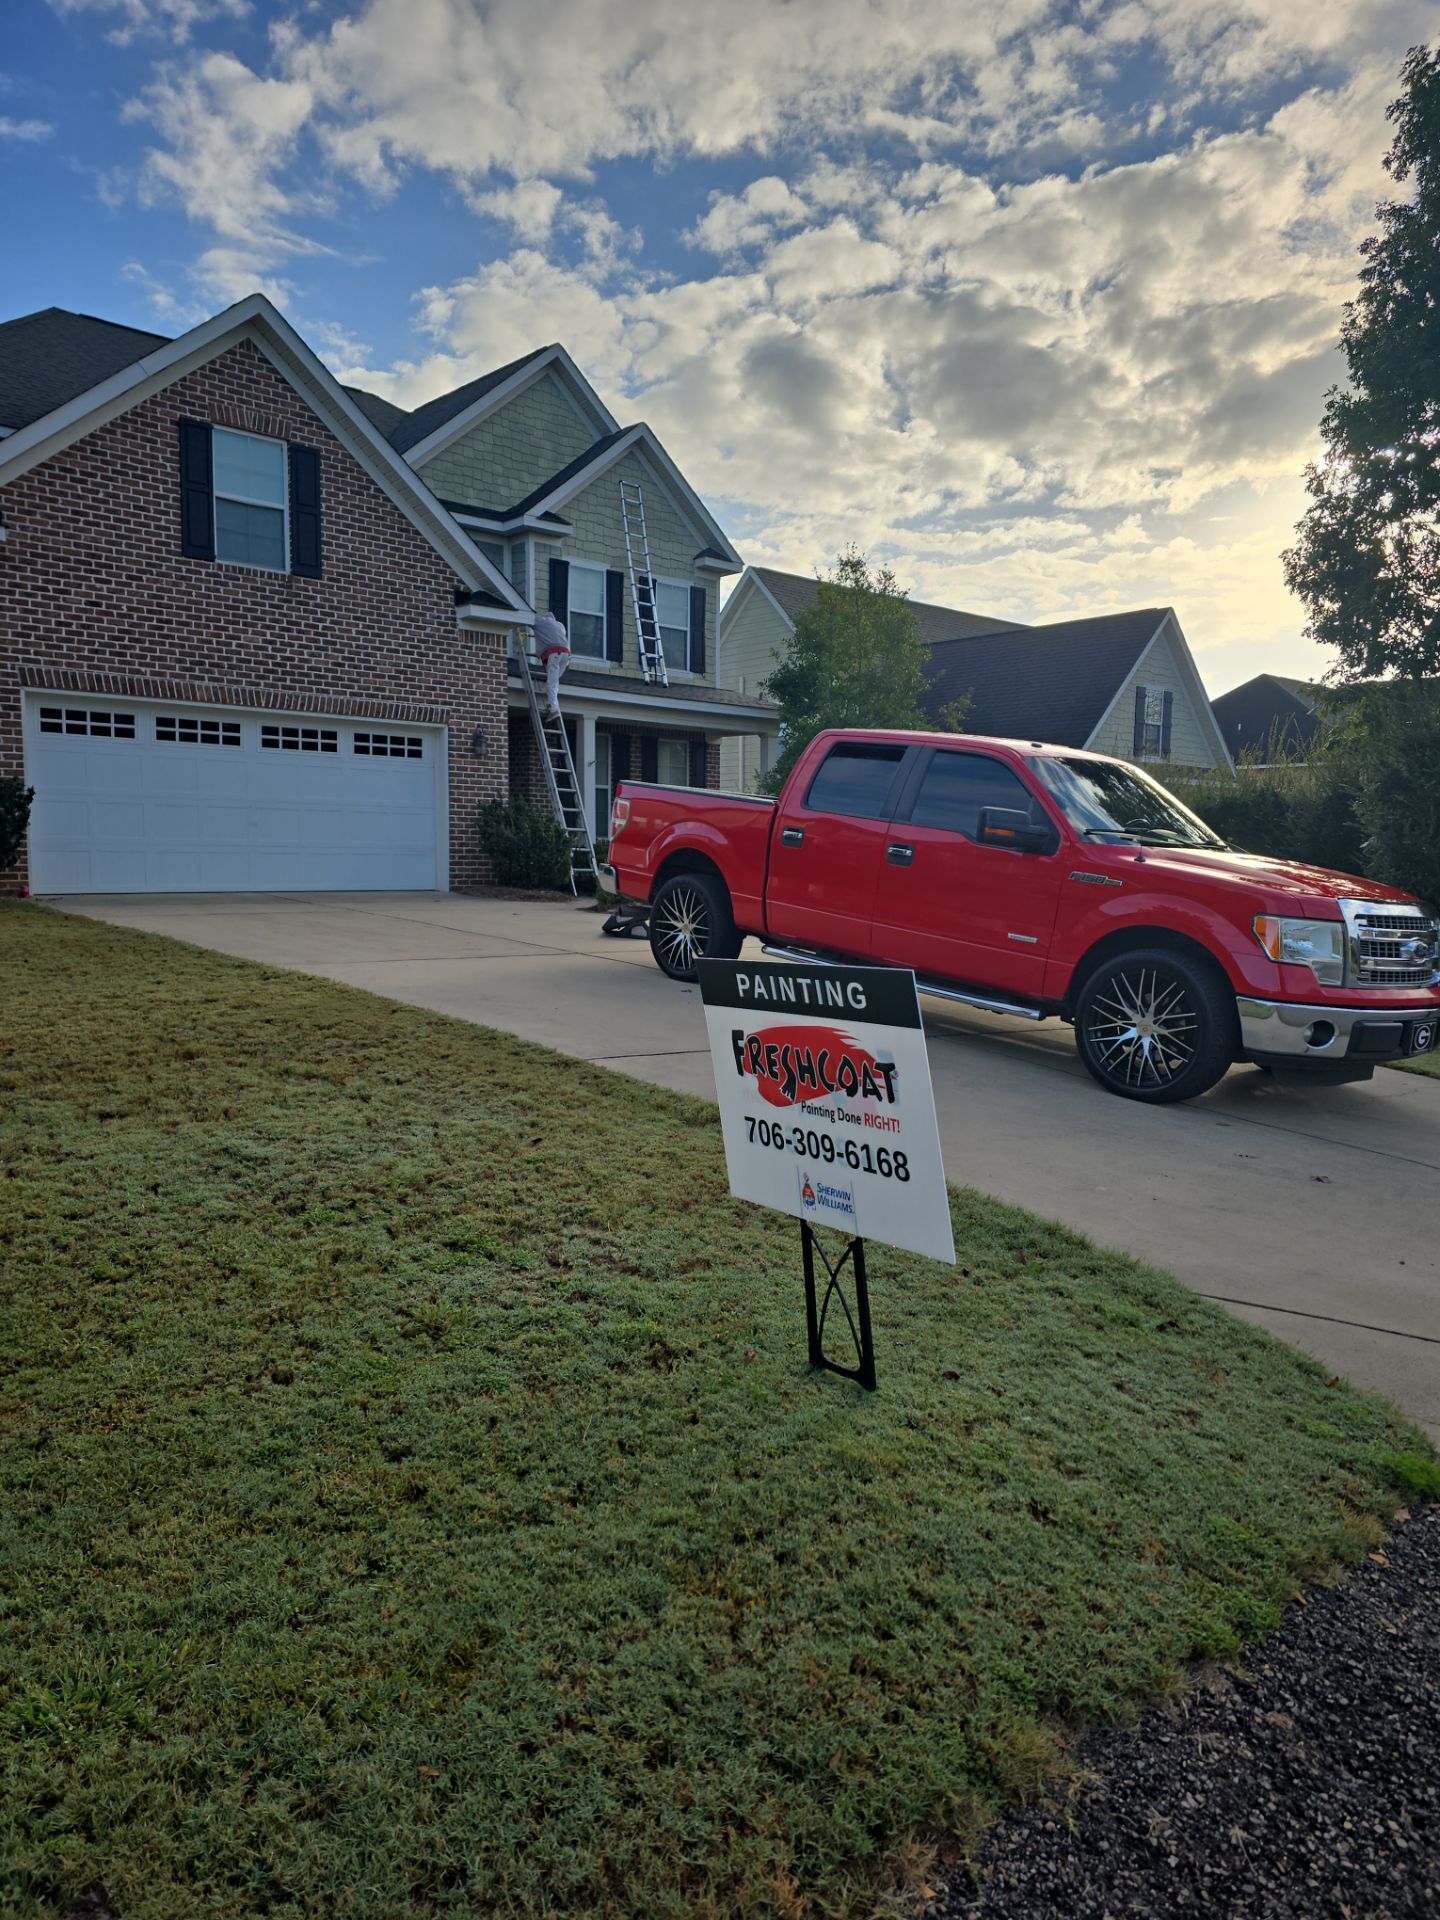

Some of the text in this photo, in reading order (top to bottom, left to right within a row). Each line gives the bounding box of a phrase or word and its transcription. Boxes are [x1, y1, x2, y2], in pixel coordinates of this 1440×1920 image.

[735, 973, 867, 1010] PAINTING
[732, 1029, 897, 1104] FRESHCOAT
[801, 1101, 901, 1133] Painting Done RIGHT!
[744, 1116, 910, 1182] 706-309-6168
[817, 1182, 851, 1202] SHERWIN
